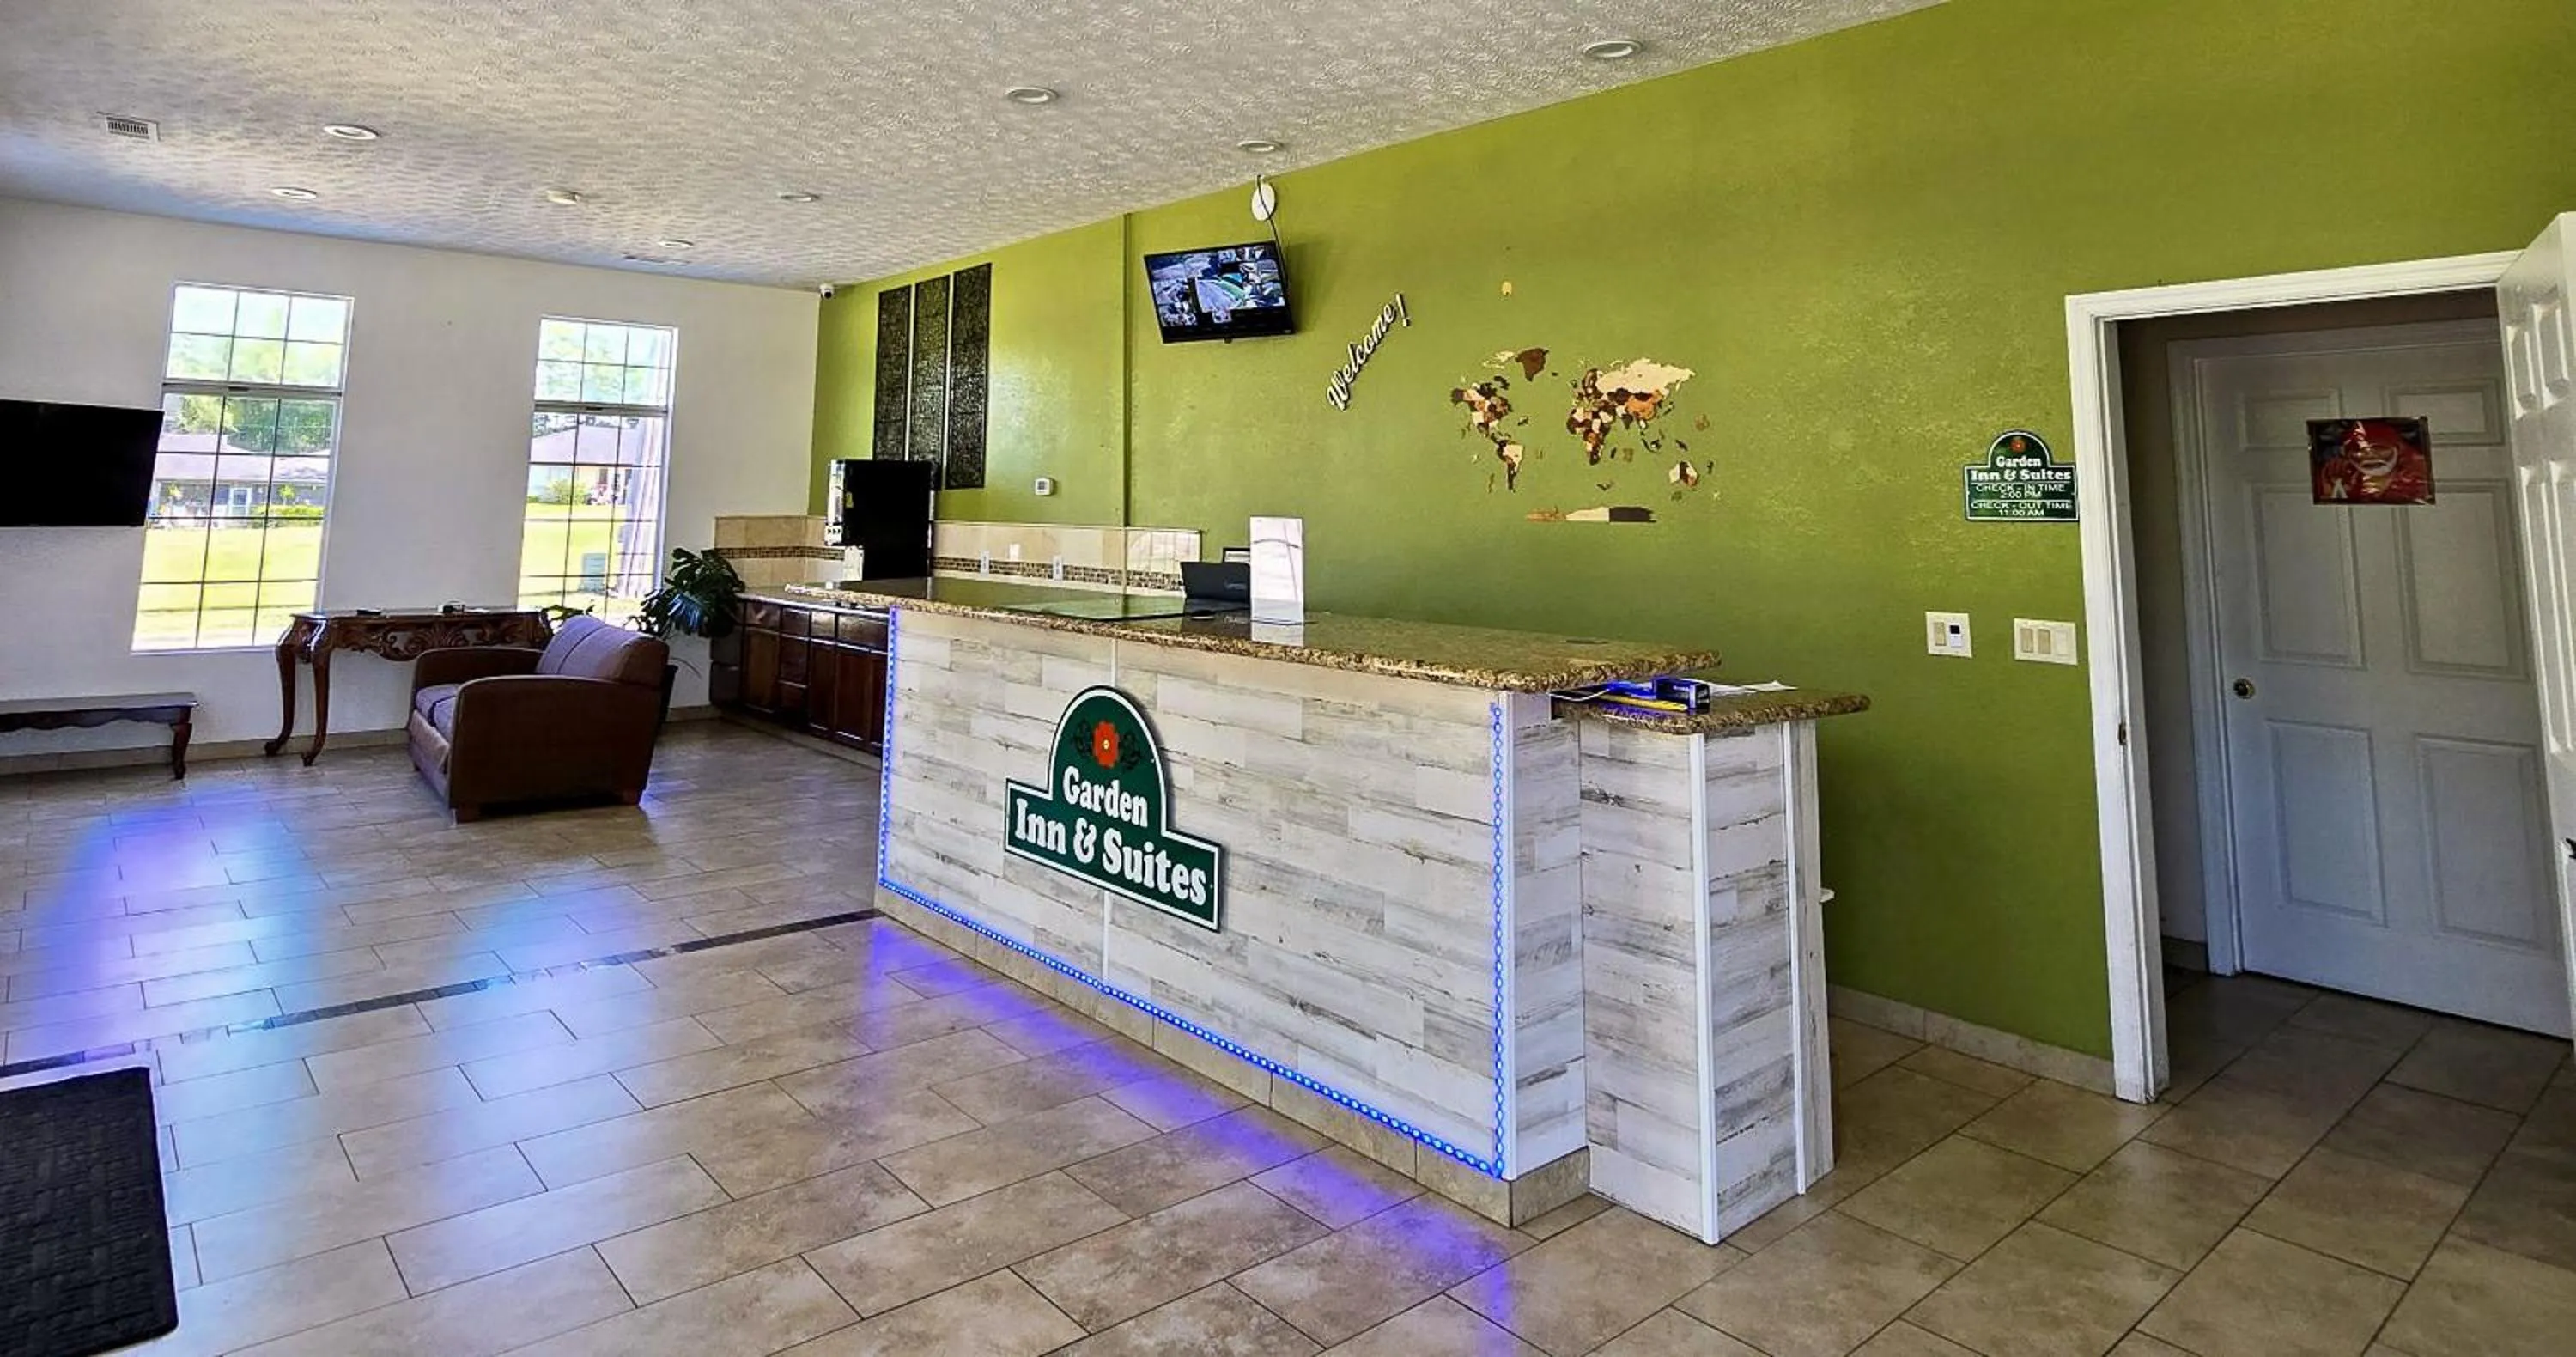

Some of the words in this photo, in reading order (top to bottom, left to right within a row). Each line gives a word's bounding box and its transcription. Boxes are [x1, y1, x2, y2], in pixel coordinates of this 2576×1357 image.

[1996, 455, 2042, 467] Garden
[1971, 470, 2001, 480] Inn
[2004, 469, 2016, 481] &
[2020, 469, 2071, 480] Suites
[1976, 484, 2014, 492] CHECK
[2038, 484, 2065, 492] TIME
[1971, 501, 2009, 509] CHECK
[2019, 501, 2042, 509] OUT
[2045, 501, 2072, 509] TIME
[1063, 765, 1148, 828] Garden
[1014, 798, 1066, 855] Inn
[1073, 818, 1097, 865] &
[1103, 828, 1206, 906] Suites
